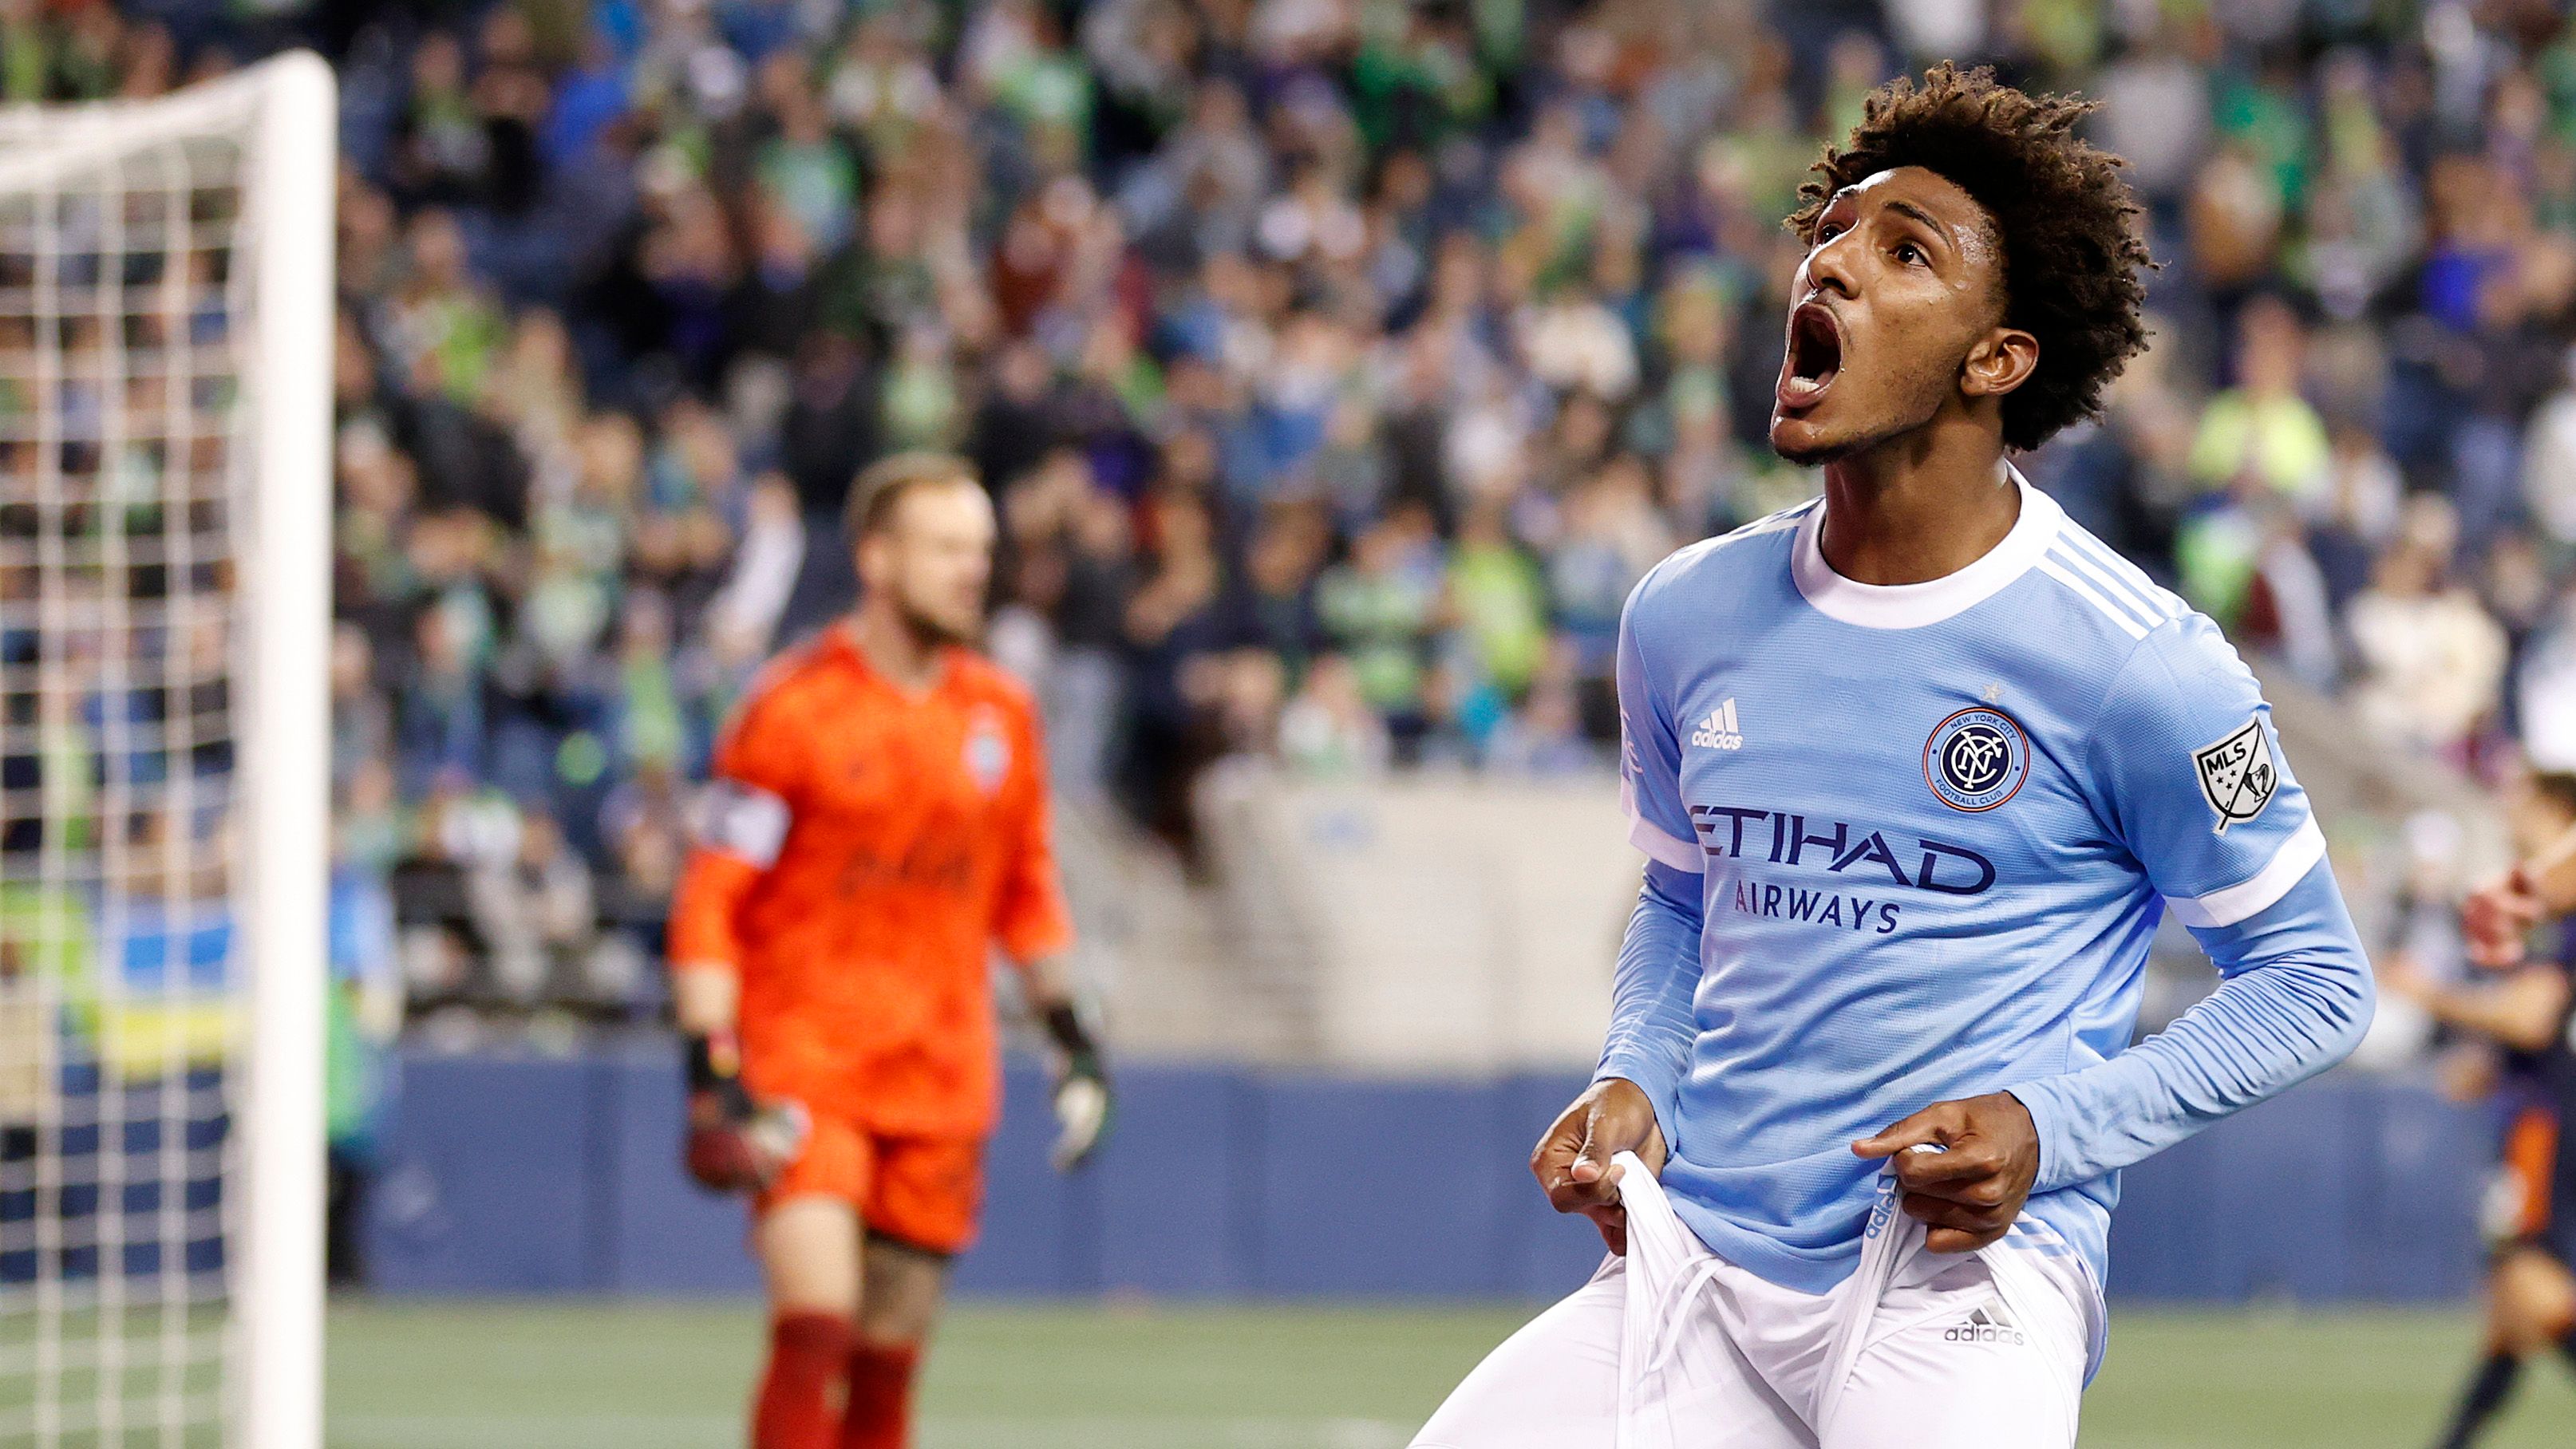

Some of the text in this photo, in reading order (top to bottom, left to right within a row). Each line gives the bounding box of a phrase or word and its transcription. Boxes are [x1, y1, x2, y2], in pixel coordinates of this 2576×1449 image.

[1692, 730, 1744, 750] adidas
[1951, 714, 2017, 740] NEW YORK CITY
[2206, 741, 2246, 776] MLS
[1935, 779, 2003, 805] FOOTBALL CLUB
[1689, 805, 1996, 894] ETIHAD
[1735, 879, 1900, 934] AIRWAYS
[1944, 1324, 2025, 1347] adidas
